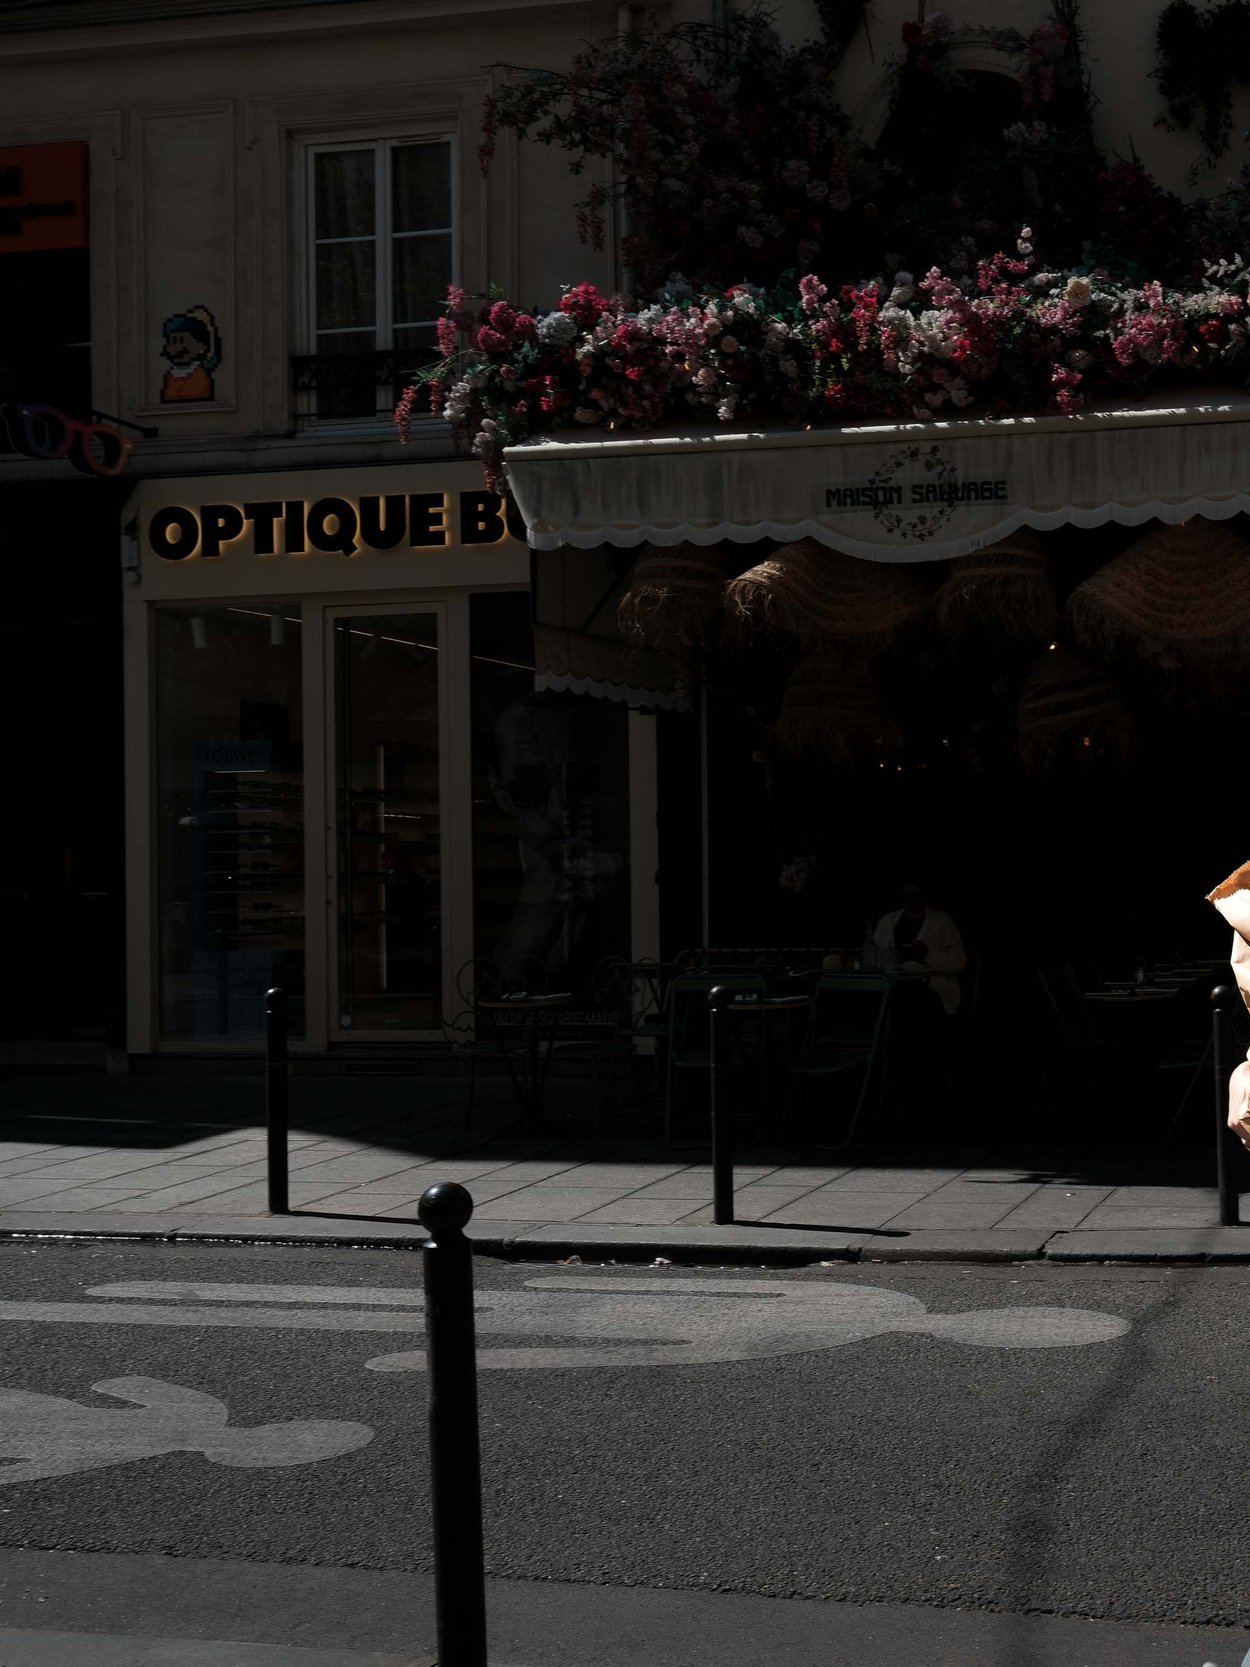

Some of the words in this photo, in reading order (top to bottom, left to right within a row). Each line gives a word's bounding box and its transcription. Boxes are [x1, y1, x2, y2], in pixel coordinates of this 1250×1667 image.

[825, 485, 903, 508] MAISON
[911, 480, 1008, 504] SAUVAGE
[149, 493, 447, 560] OPTIQUE
[203, 748, 257, 763] LOEWE
